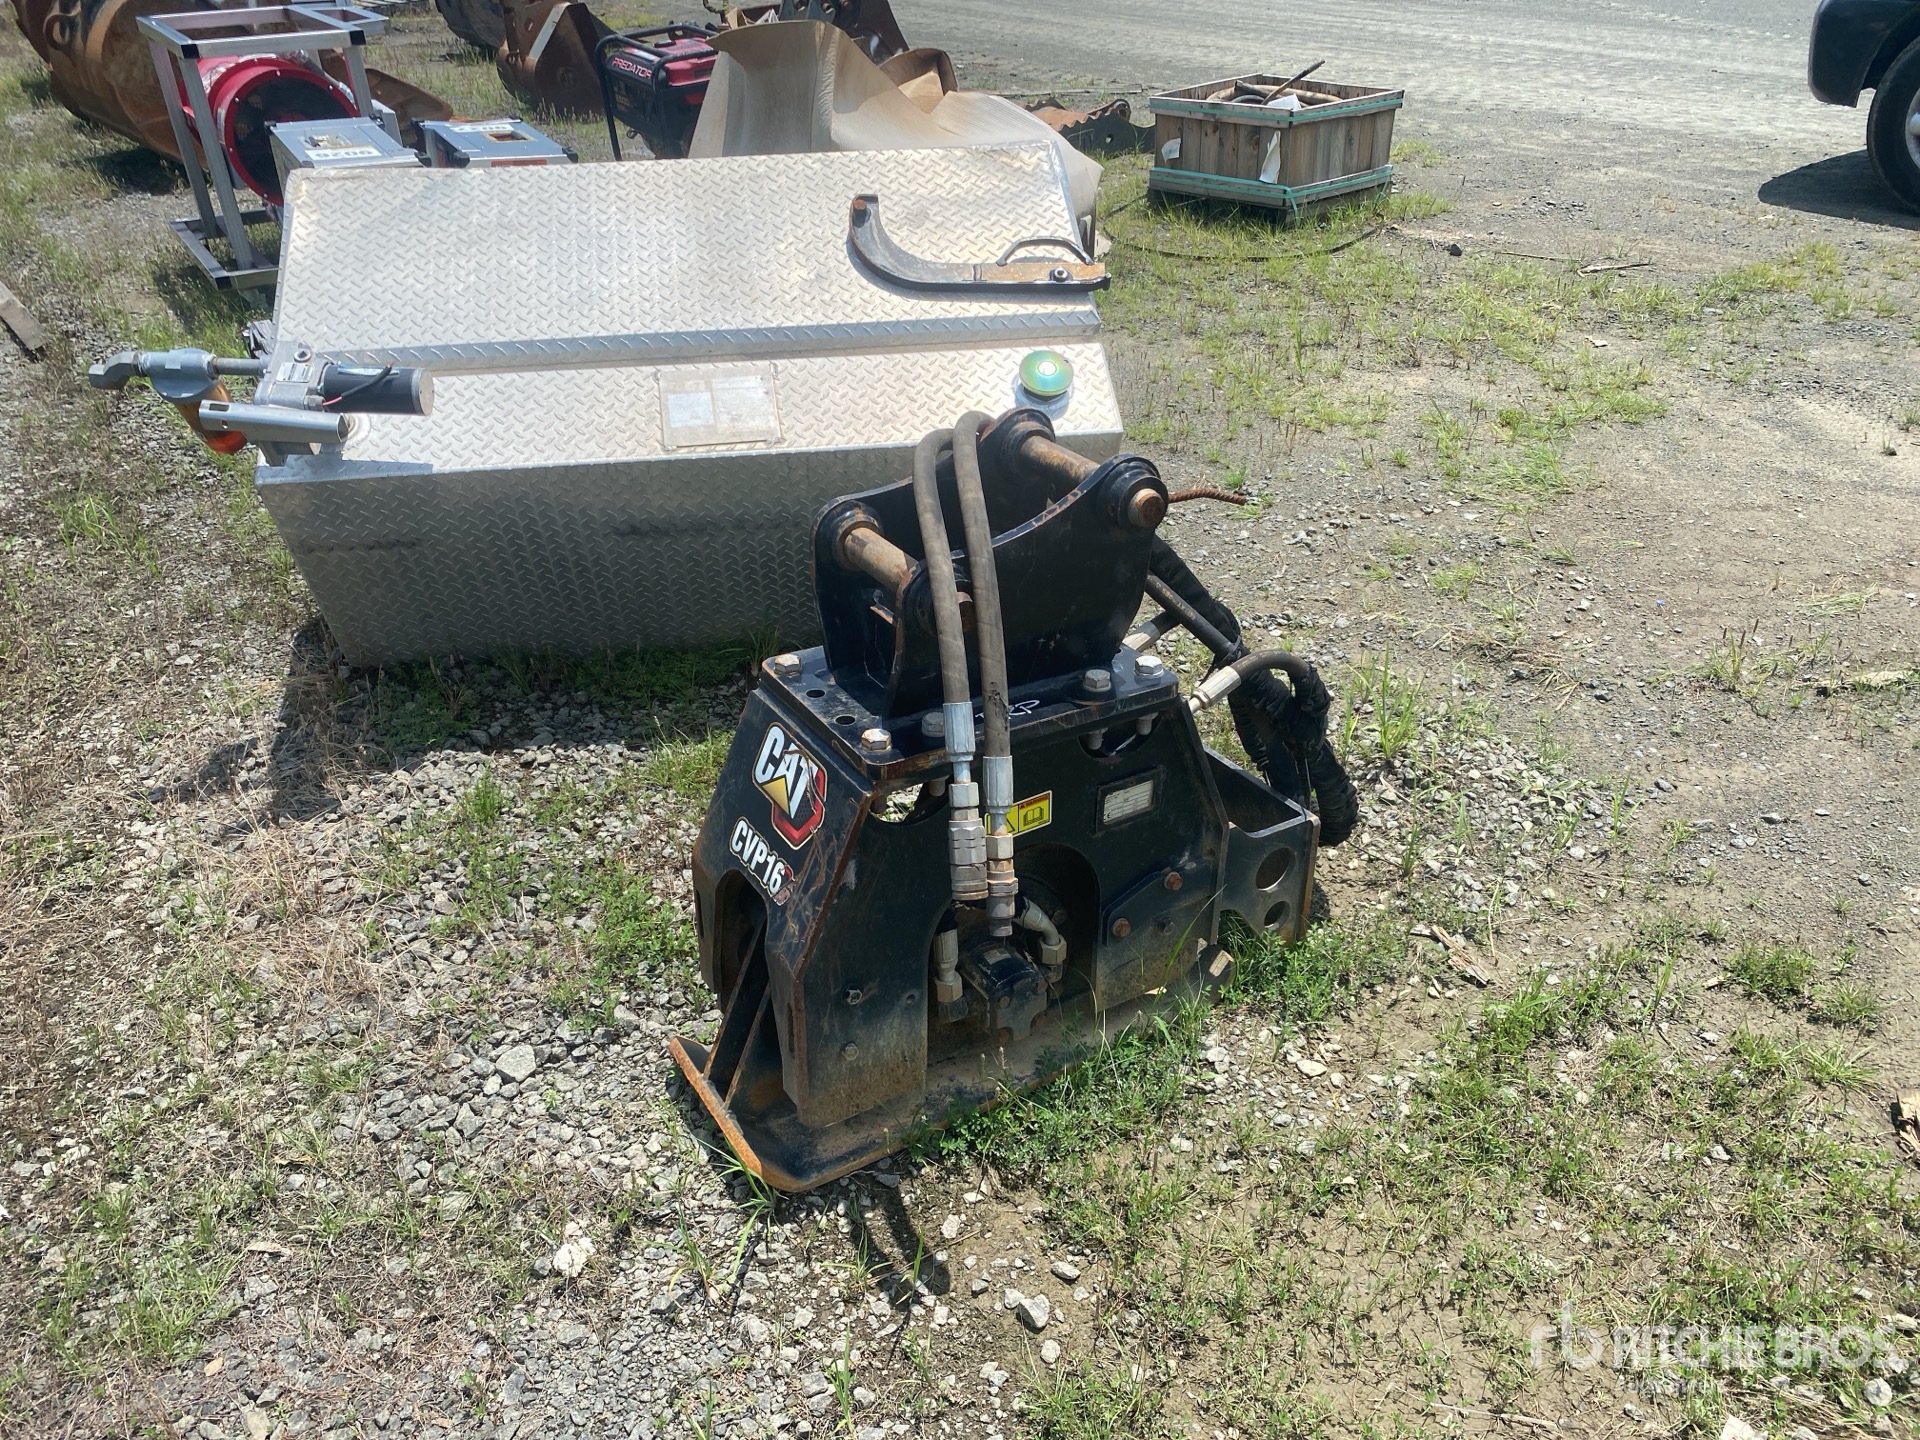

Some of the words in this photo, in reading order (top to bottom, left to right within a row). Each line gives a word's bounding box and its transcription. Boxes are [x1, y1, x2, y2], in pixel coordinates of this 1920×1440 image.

[612, 57, 653, 79] PREDATOR
[755, 726, 818, 819] CAT
[731, 820, 785, 894] CVP16
